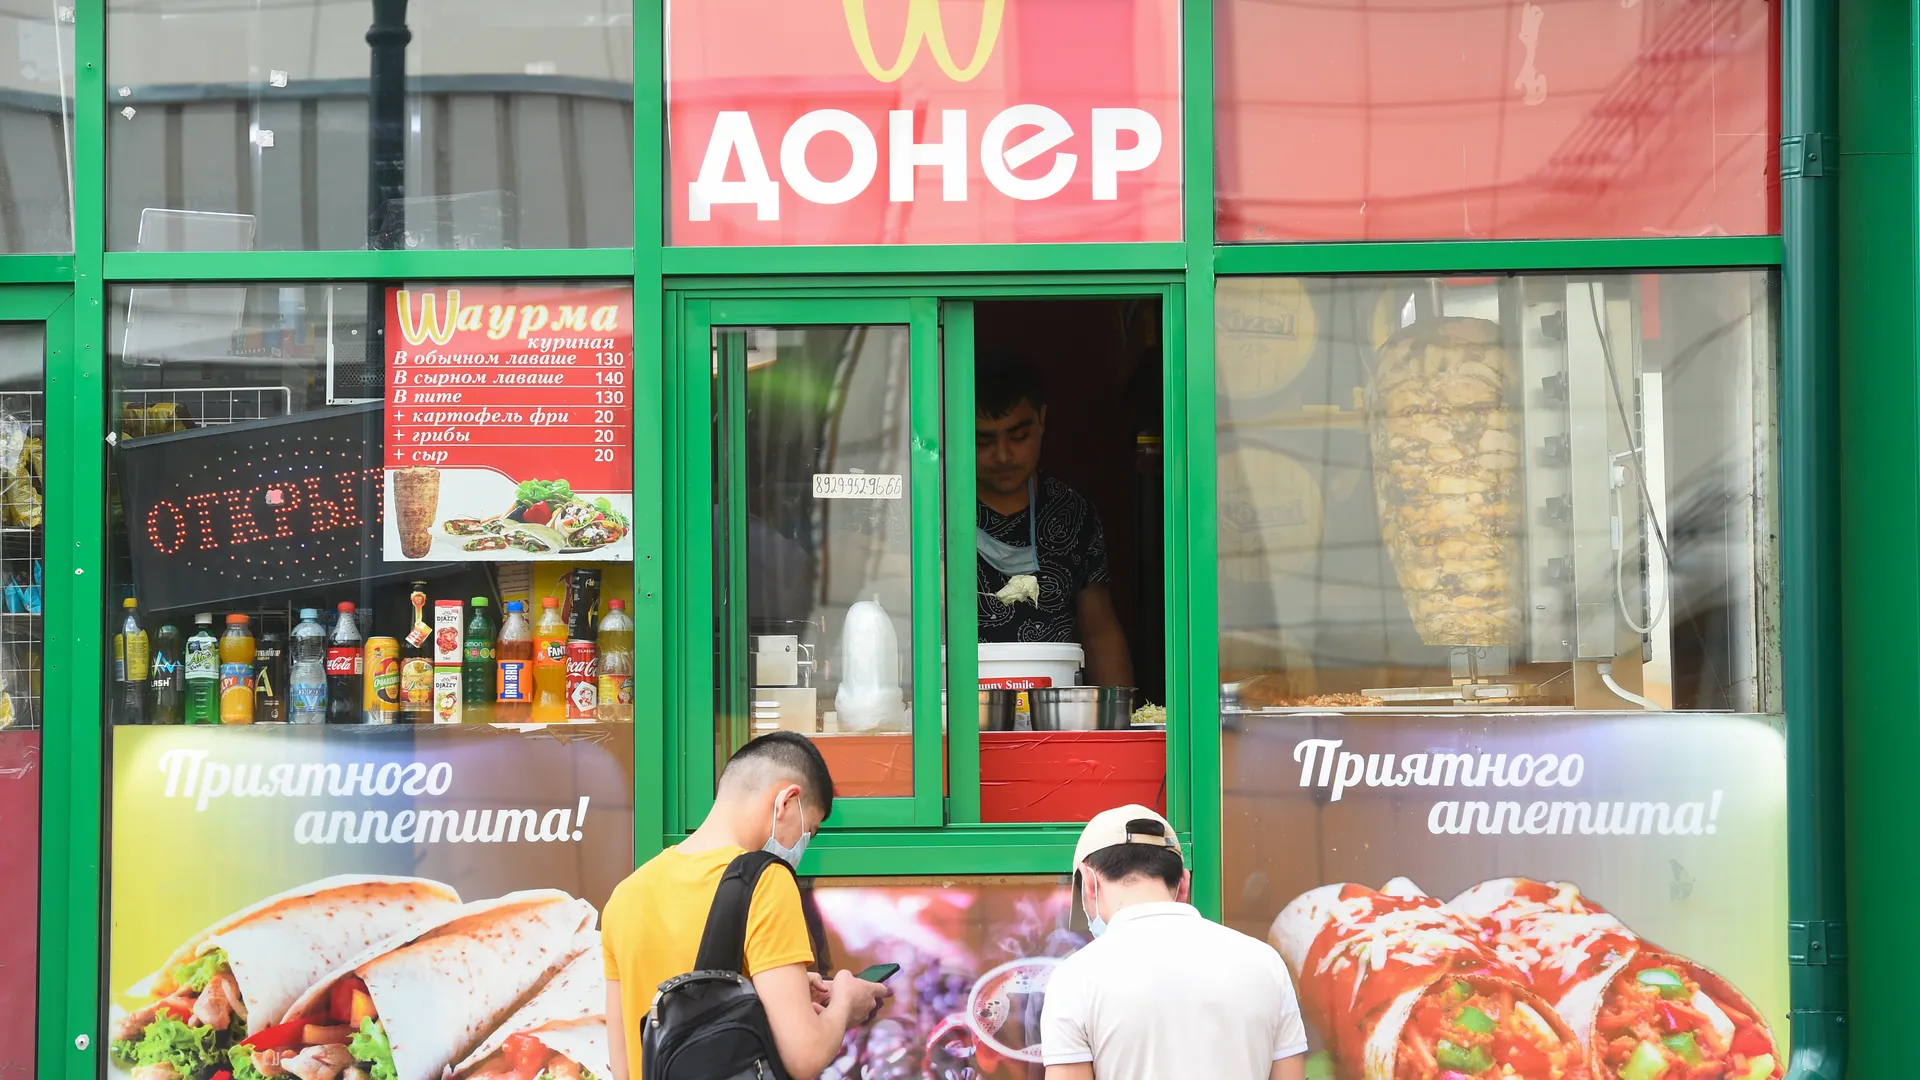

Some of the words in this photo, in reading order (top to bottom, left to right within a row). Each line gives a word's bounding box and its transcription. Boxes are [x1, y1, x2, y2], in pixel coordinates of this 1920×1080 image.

[527, 336, 614, 352] куриная
[393, 351, 408, 365] В
[413, 350, 500, 365] обычном
[505, 353, 577, 365] лаваше
[595, 352, 624, 366] 130
[393, 370, 408, 384] В
[413, 373, 487, 387] сырном
[492, 373, 564, 385] лаваше
[595, 371, 624, 385] 140
[393, 389, 408, 404] В
[413, 392, 462, 404] пите
[595, 390, 624, 404] 130
[412, 407, 523, 425] картофель
[529, 407, 569, 425] фри
[594, 409, 614, 424] 20
[412, 426, 470, 445] грибы
[594, 429, 614, 443] 20
[412, 450, 448, 465] сыр
[594, 448, 614, 462] 20
[1005, 680, 1035, 690] Smile
[1293, 738, 1585, 802] Приятного
[158, 749, 453, 812] Приятного
[294, 796, 590, 844] аппетита!
[1428, 789, 1724, 835] аппетита!
